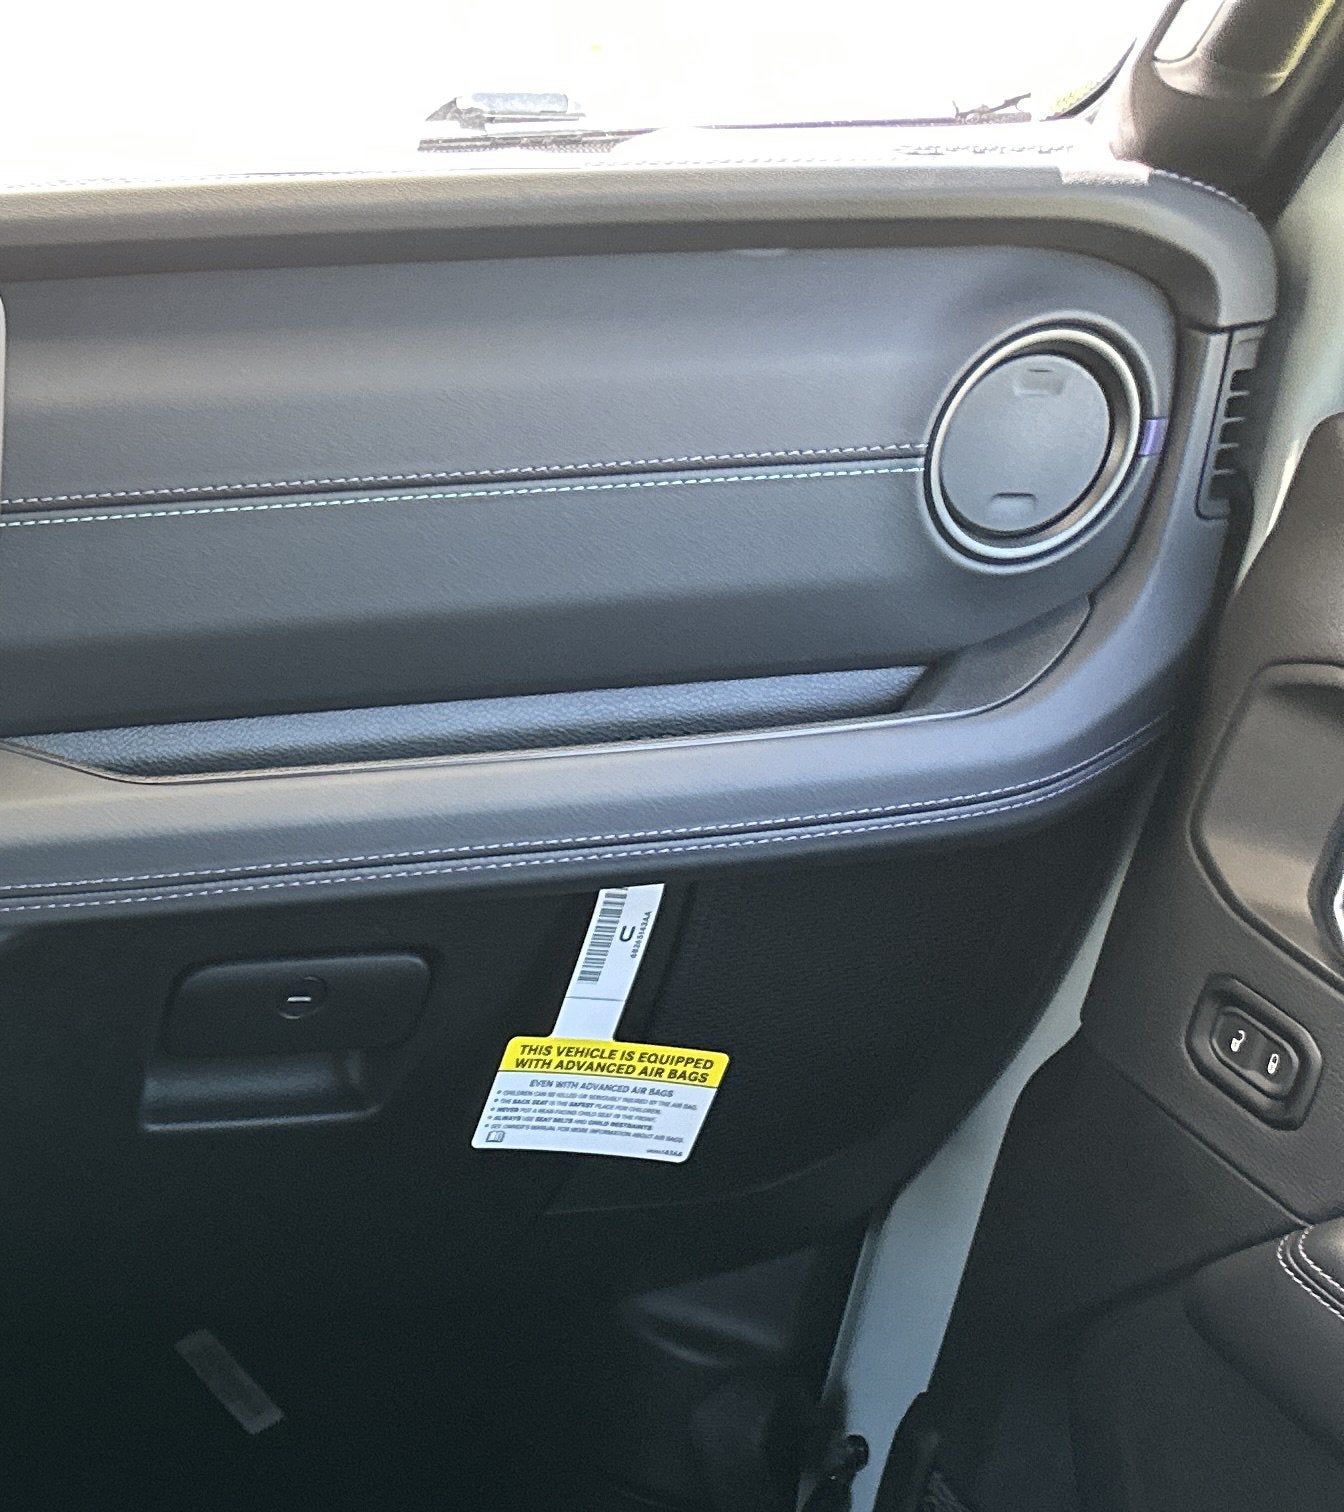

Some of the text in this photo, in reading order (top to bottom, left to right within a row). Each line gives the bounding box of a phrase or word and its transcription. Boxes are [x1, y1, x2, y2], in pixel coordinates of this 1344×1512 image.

[619, 925, 636, 942] U
[520, 1044, 715, 1071] THIS VEHICLE IS EQUIPPED
[515, 1057, 710, 1084] WITH ADVANCED AIR BAGS
[529, 1079, 553, 1088] EVEN
[580, 1082, 629, 1092] ADVANCED
[648, 1088, 674, 1097] BAGS
